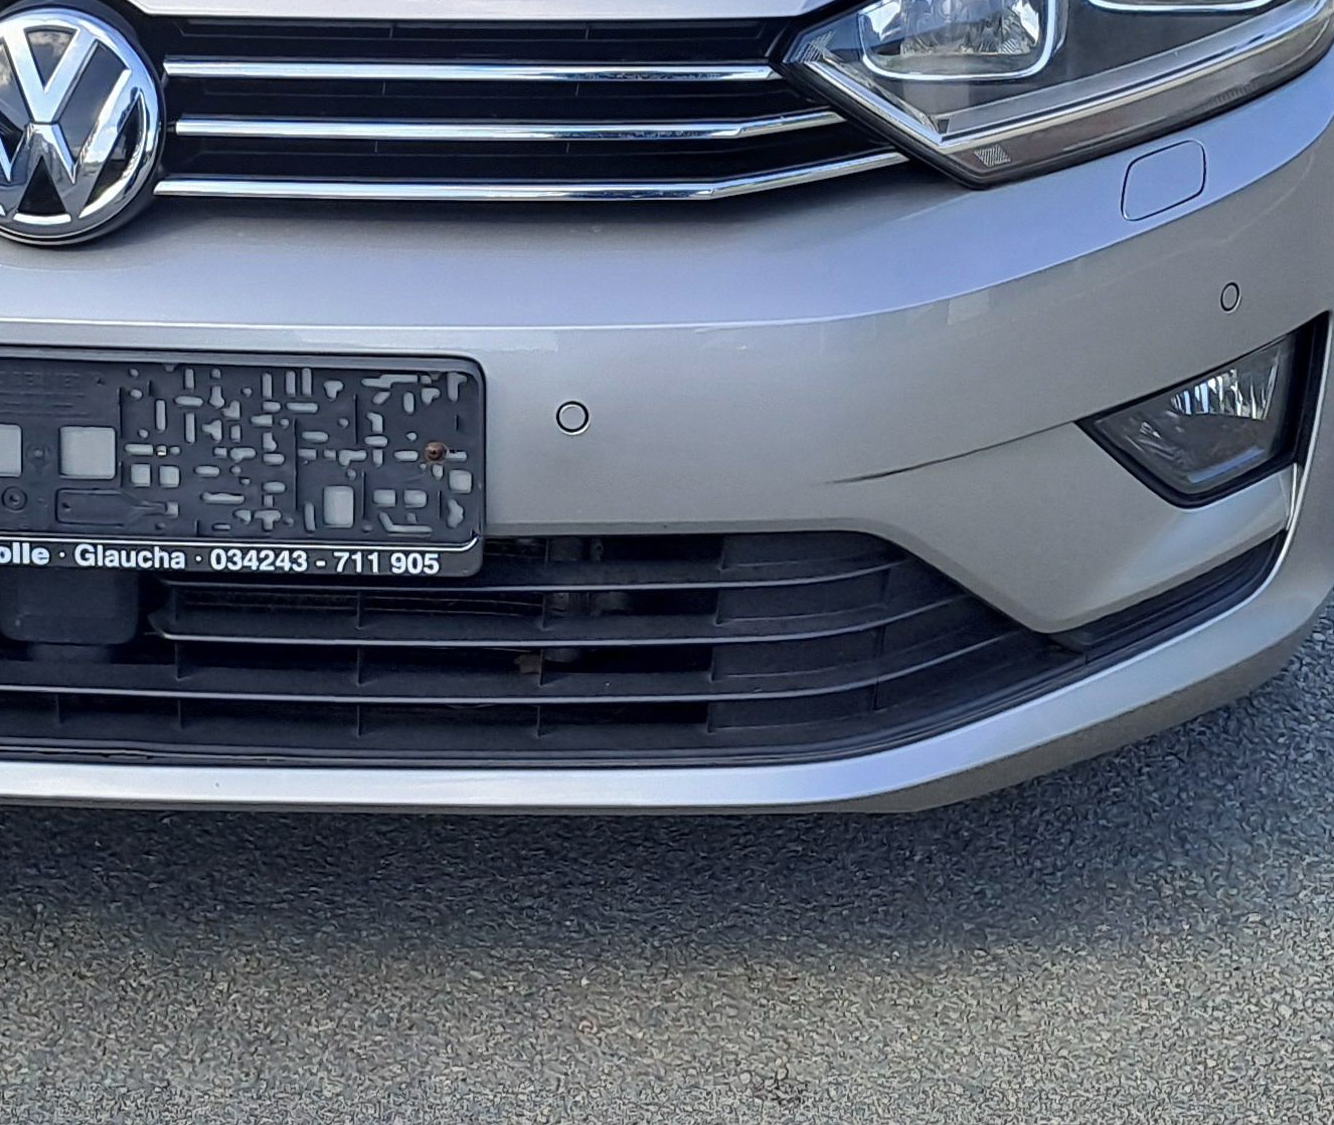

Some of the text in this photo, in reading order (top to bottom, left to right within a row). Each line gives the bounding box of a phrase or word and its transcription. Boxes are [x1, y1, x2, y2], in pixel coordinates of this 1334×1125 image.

[74, 544, 186, 570] Glaucha
[210, 548, 308, 572] 034243
[333, 551, 380, 573] 711
[390, 552, 440, 574] 905
